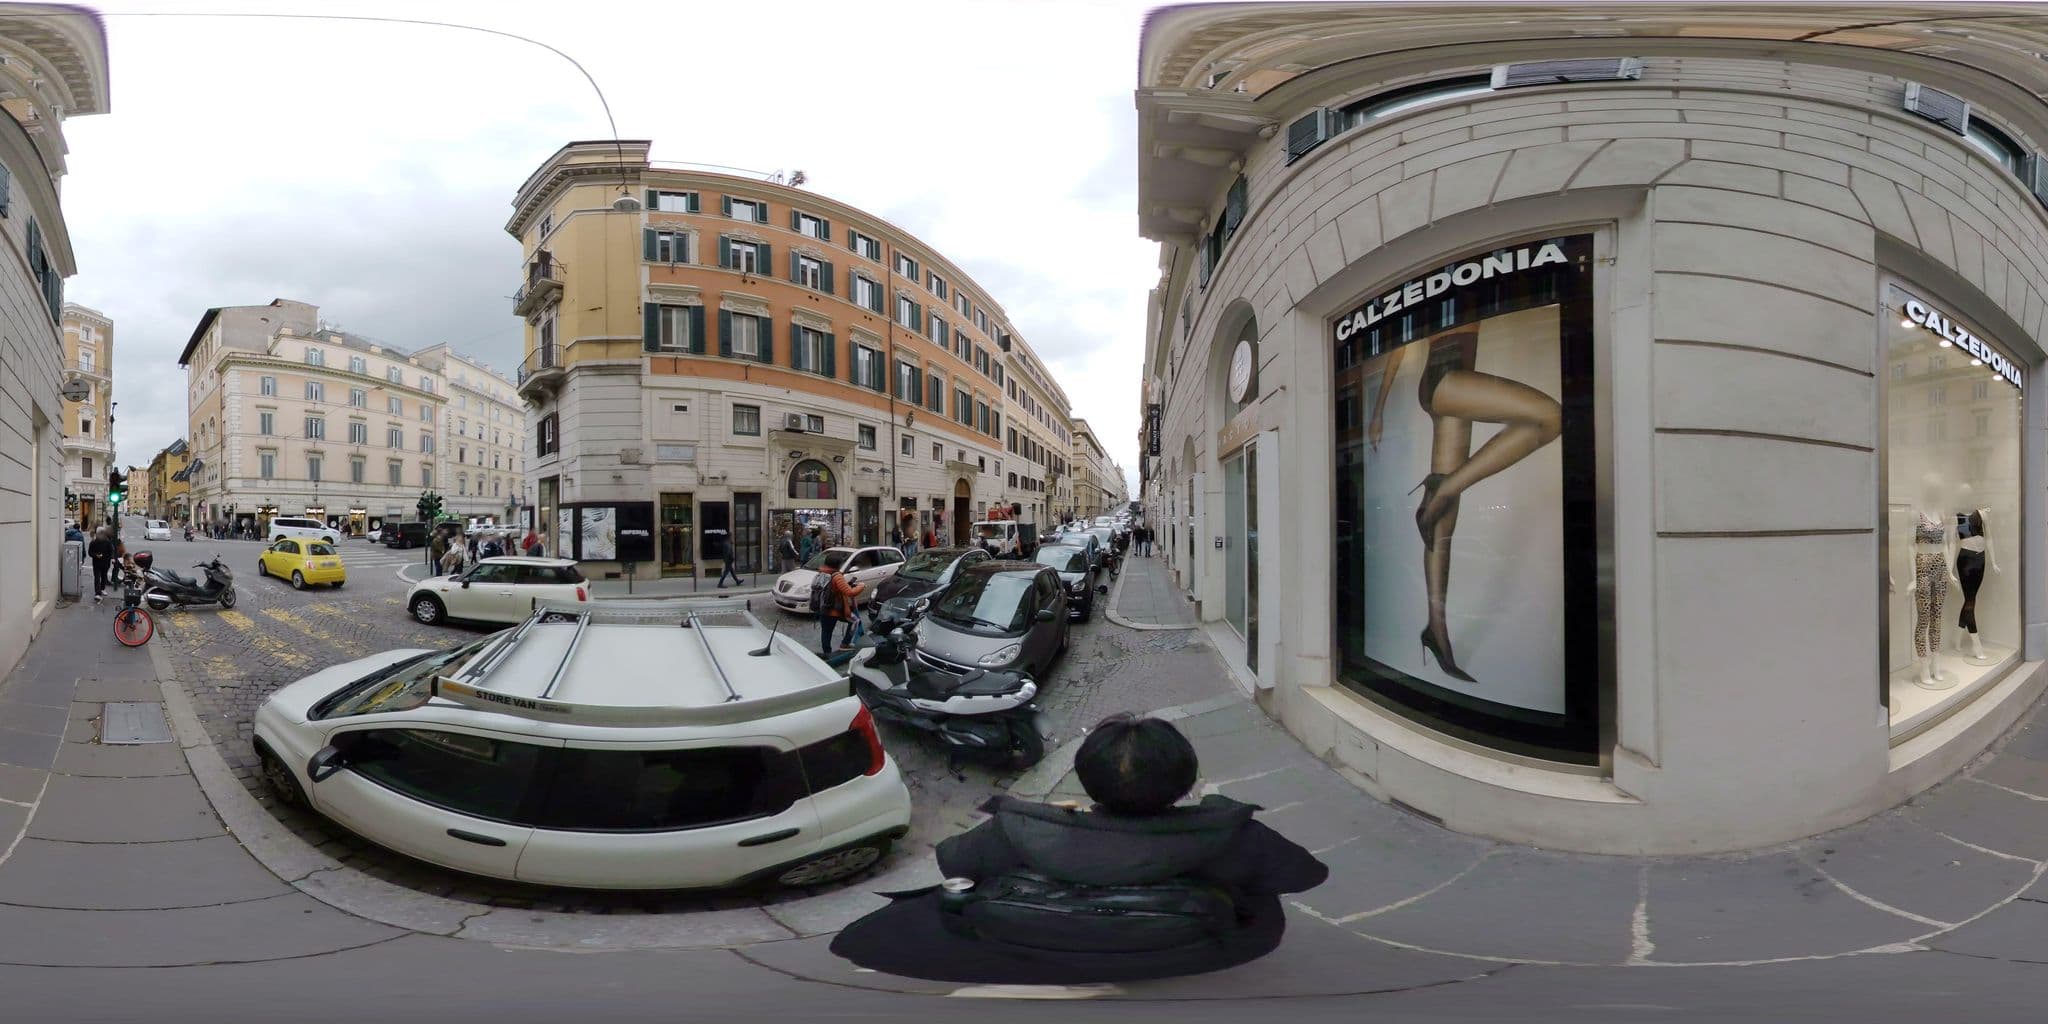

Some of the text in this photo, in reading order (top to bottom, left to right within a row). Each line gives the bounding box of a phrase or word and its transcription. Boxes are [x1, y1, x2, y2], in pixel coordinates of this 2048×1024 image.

[1337, 244, 1568, 341] CALZEDONIA
[1905, 300, 2022, 388] CALZEDONIA
[476, 691, 512, 705] STORE
[513, 698, 536, 709] VAN
